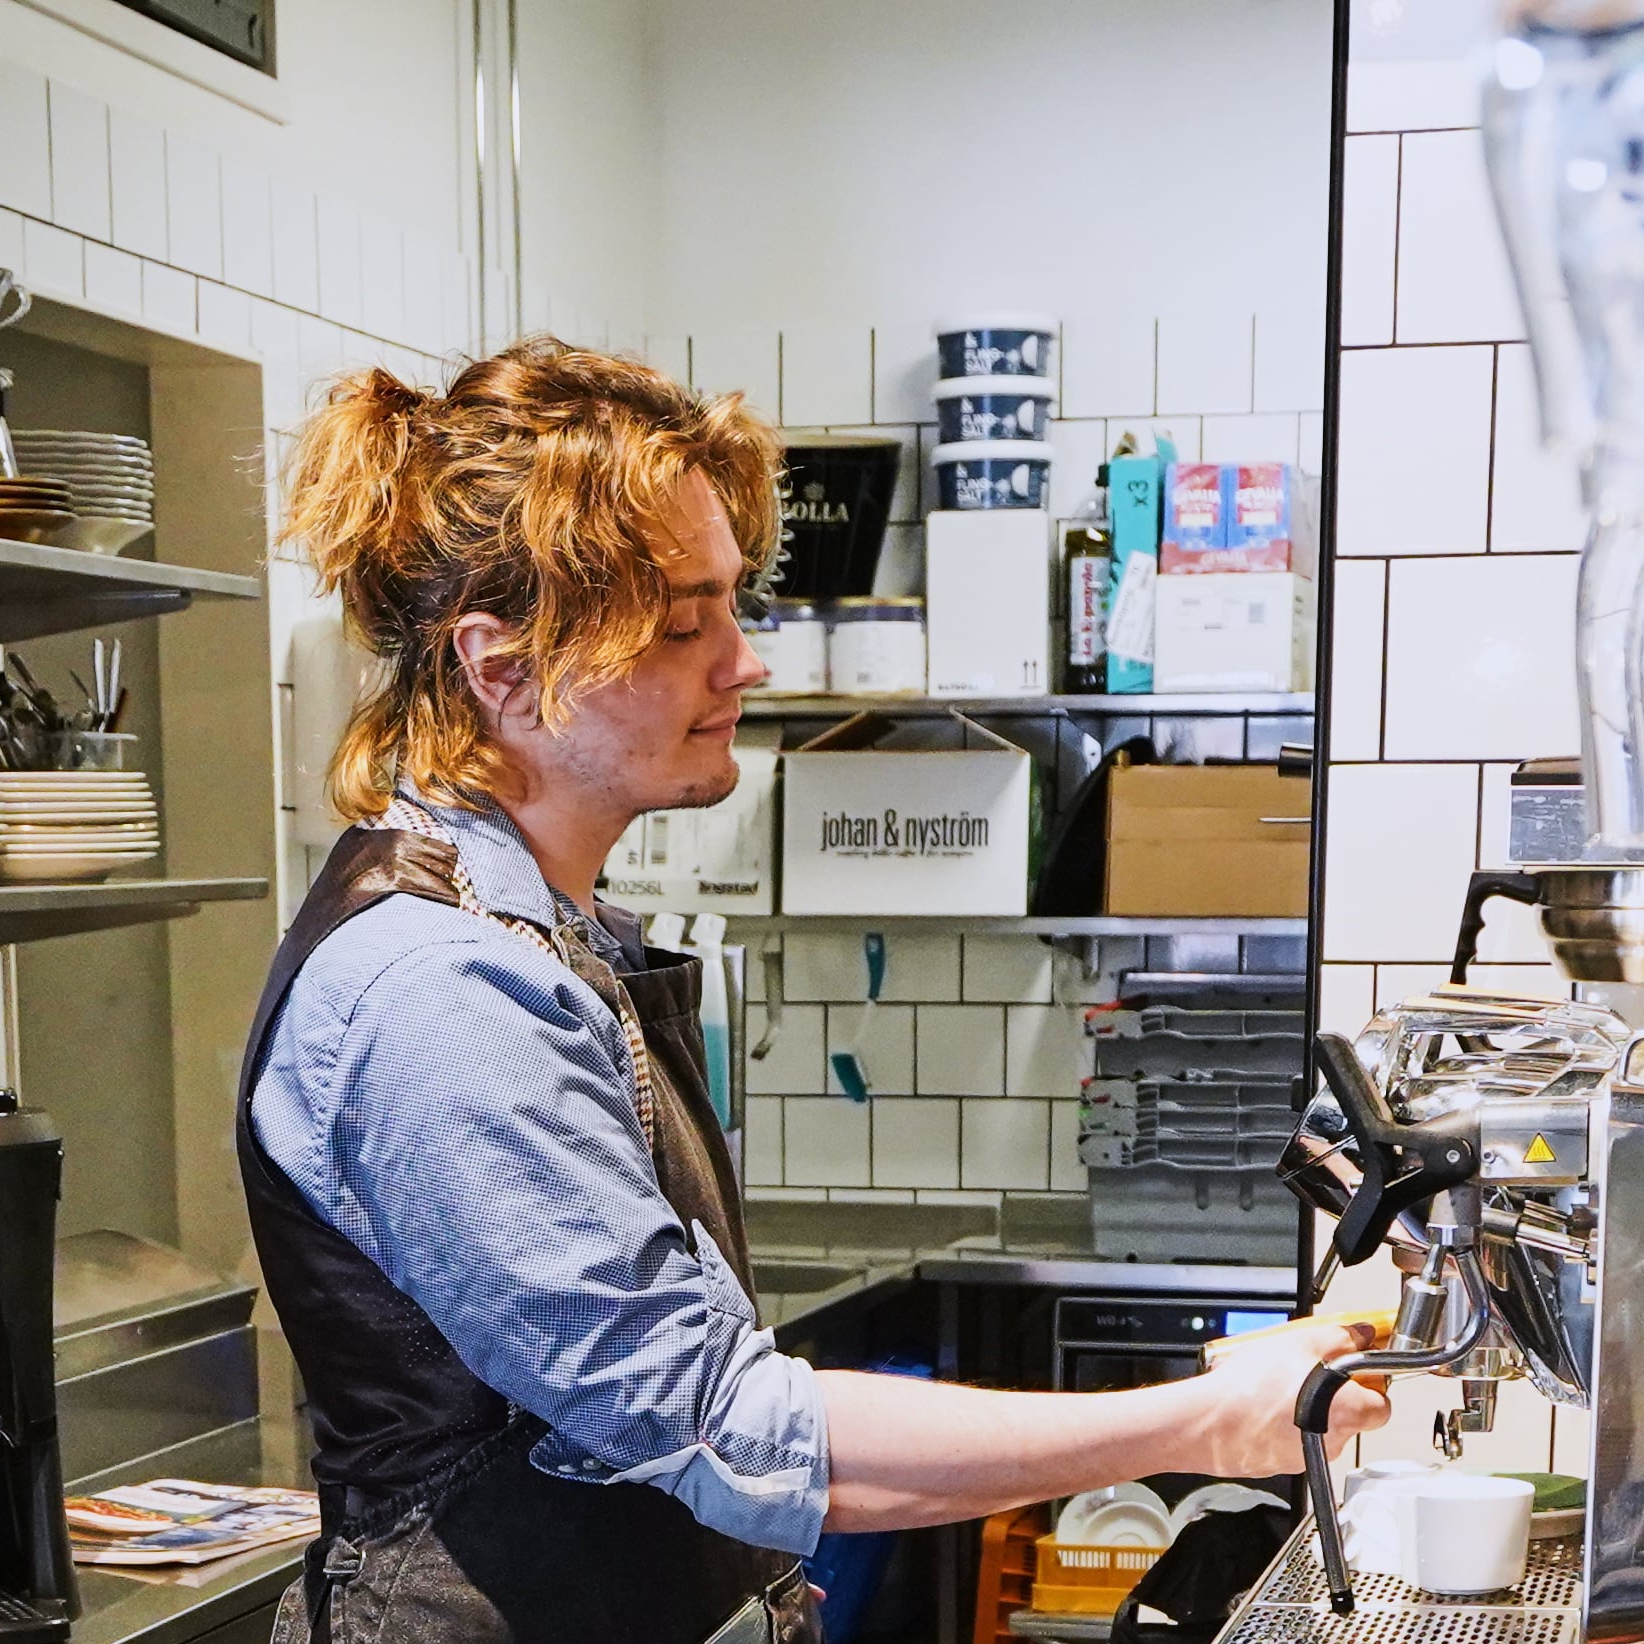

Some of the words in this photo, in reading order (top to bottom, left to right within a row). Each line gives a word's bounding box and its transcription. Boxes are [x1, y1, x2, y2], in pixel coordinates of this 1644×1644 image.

[820, 811, 877, 851] johan
[883, 808, 899, 847] &
[906, 811, 989, 854] nyström
